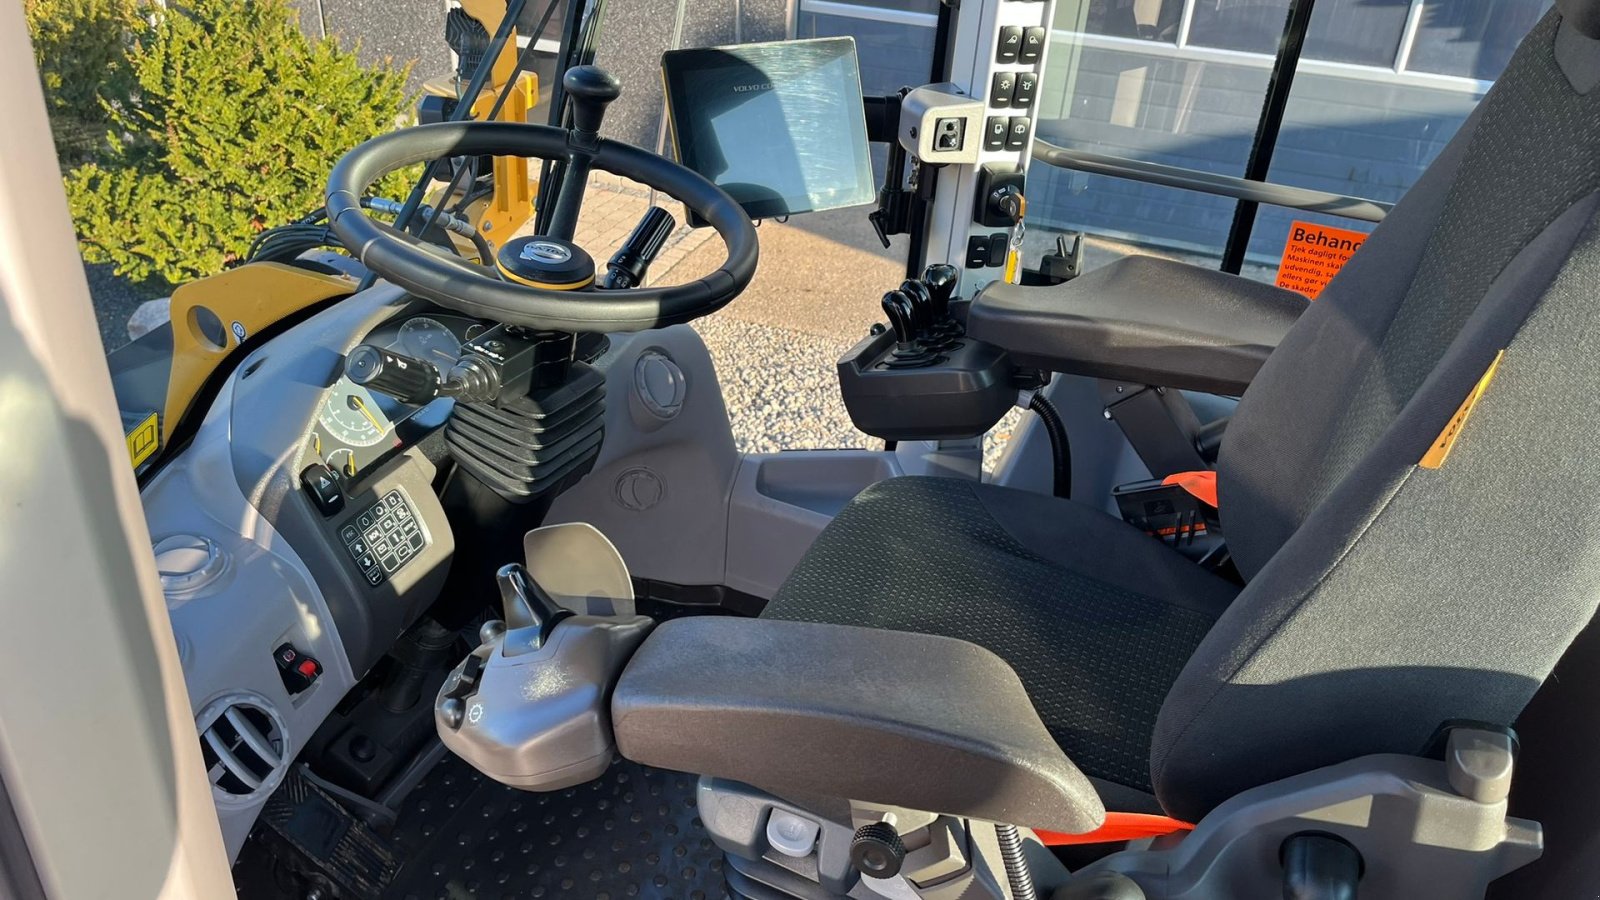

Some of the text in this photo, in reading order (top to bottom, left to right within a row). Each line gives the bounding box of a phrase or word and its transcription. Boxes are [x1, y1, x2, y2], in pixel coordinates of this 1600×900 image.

[733, 84, 760, 92] VOLVO
[1290, 245, 1305, 254] Tjek
[1308, 248, 1336, 260] dagligt
[1287, 254, 1324, 267] Maskinen
[1282, 273, 1302, 282] ellers
[1304, 276, 1318, 285] gør
[1280, 281, 1318, 294] De skader
